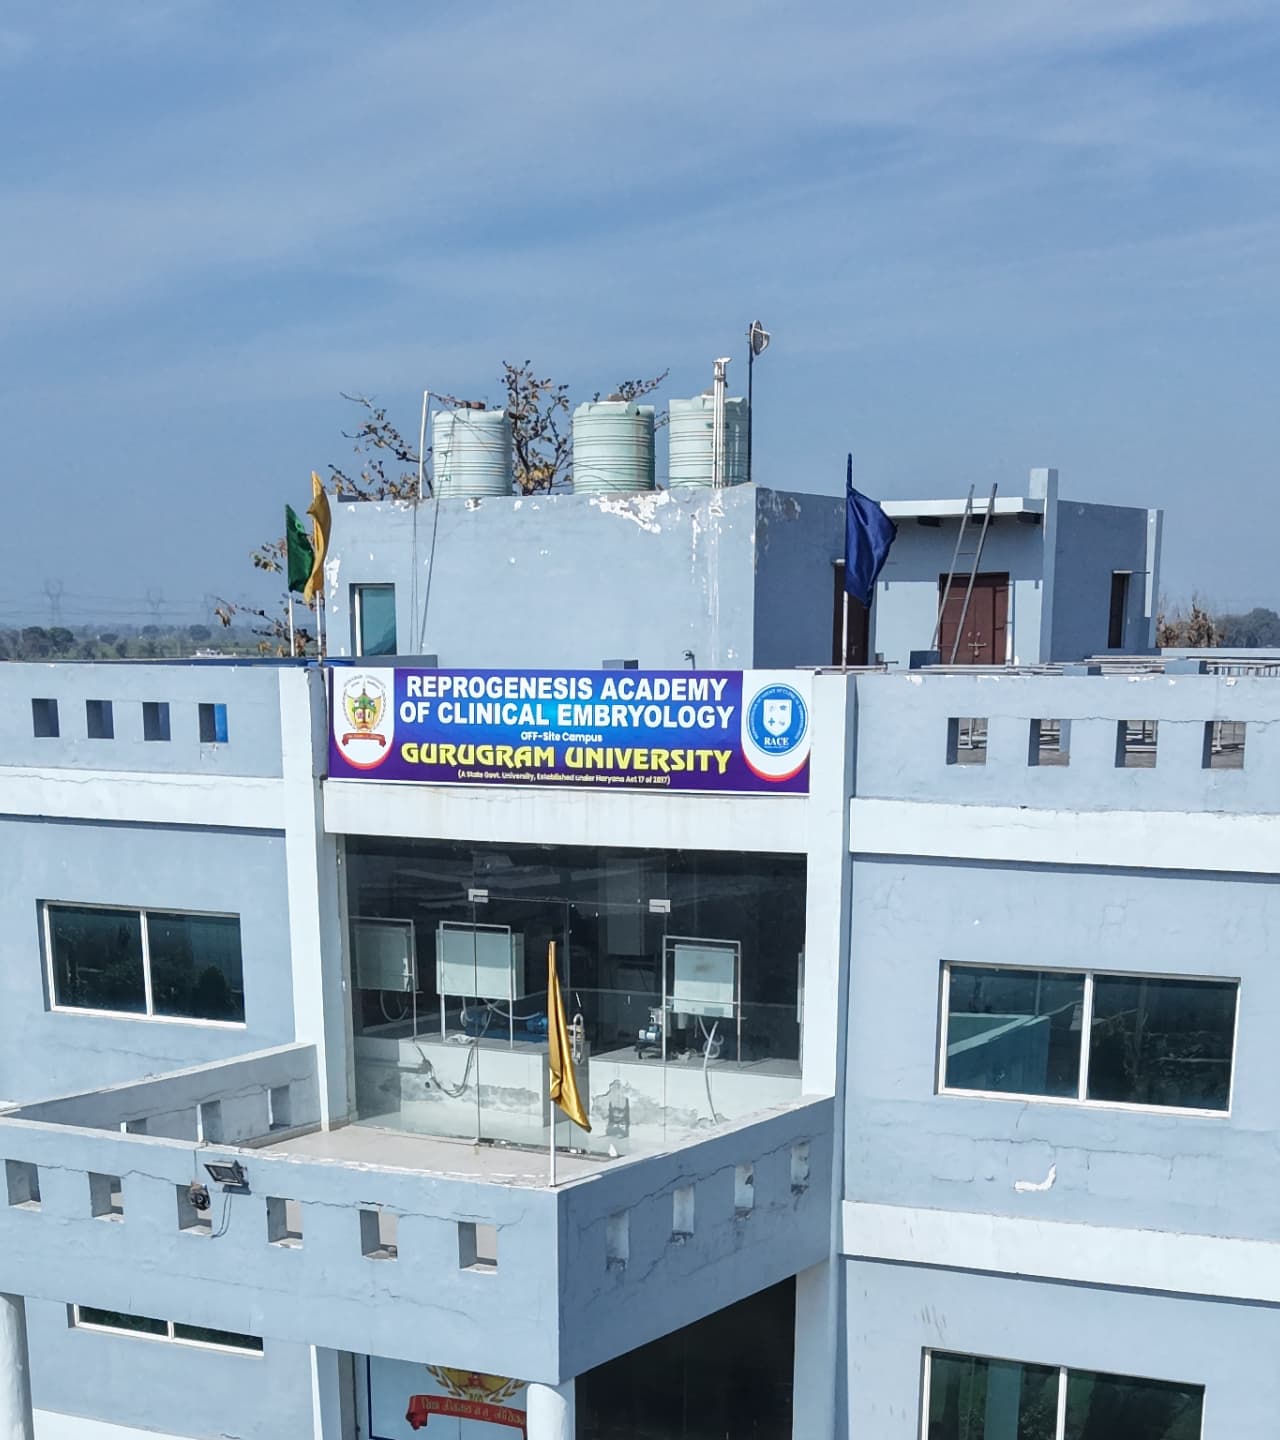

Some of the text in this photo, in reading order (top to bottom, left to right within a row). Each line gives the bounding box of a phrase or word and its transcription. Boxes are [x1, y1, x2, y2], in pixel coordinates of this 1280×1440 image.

[407, 676, 592, 700] REPROGENESIS
[600, 677, 728, 702] ACADEMY
[400, 701, 430, 723] OF
[437, 702, 549, 726] CLINICAL
[557, 703, 735, 729] EMBRYOLOGY
[562, 732, 603, 744] Campus
[764, 736, 789, 746] RACE
[401, 743, 732, 774] GURUGRAM UNIVERSITY
[575, 774, 595, 782] under
